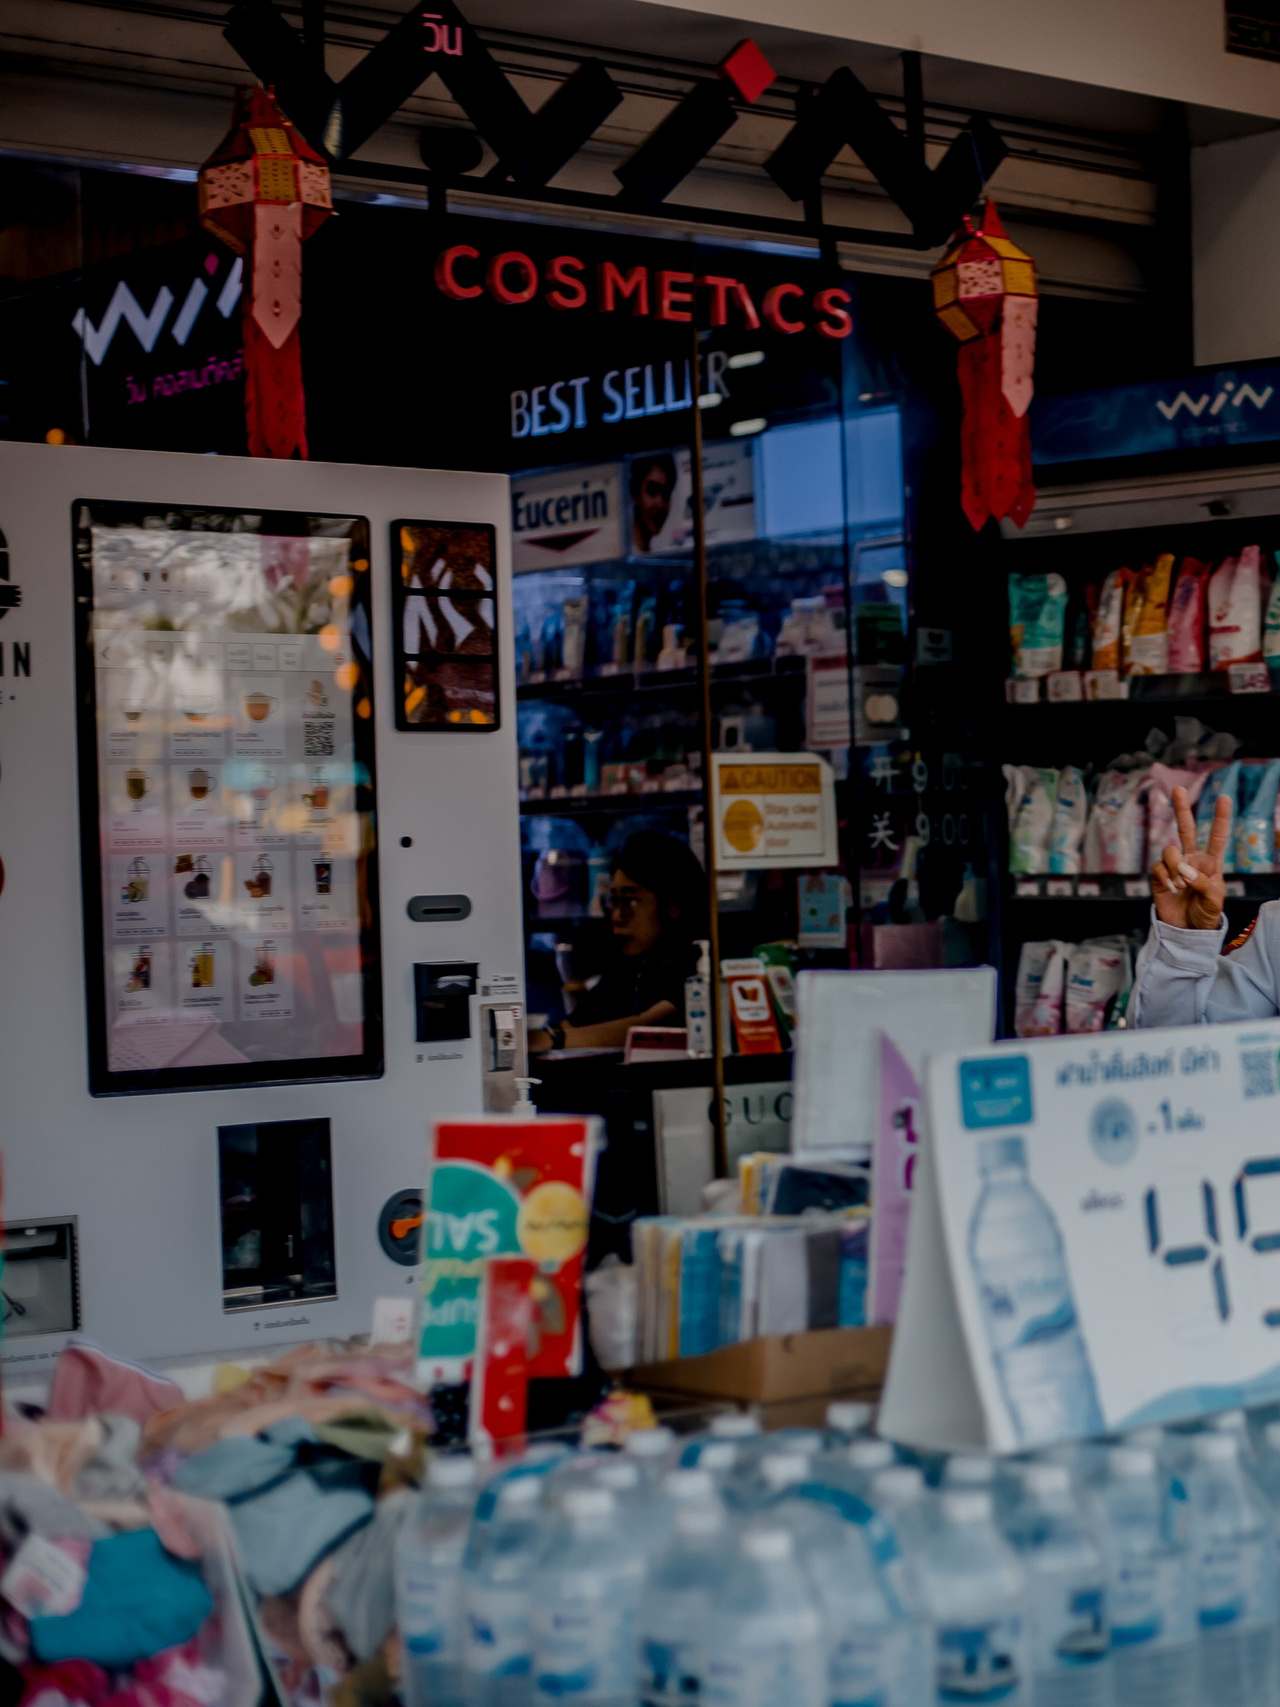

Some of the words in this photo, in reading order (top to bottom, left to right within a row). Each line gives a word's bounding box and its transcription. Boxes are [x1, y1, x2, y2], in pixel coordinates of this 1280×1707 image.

[434, 245, 853, 339] COSMETICS
[510, 376, 591, 439] BEST
[511, 481, 608, 532] Eucerin
